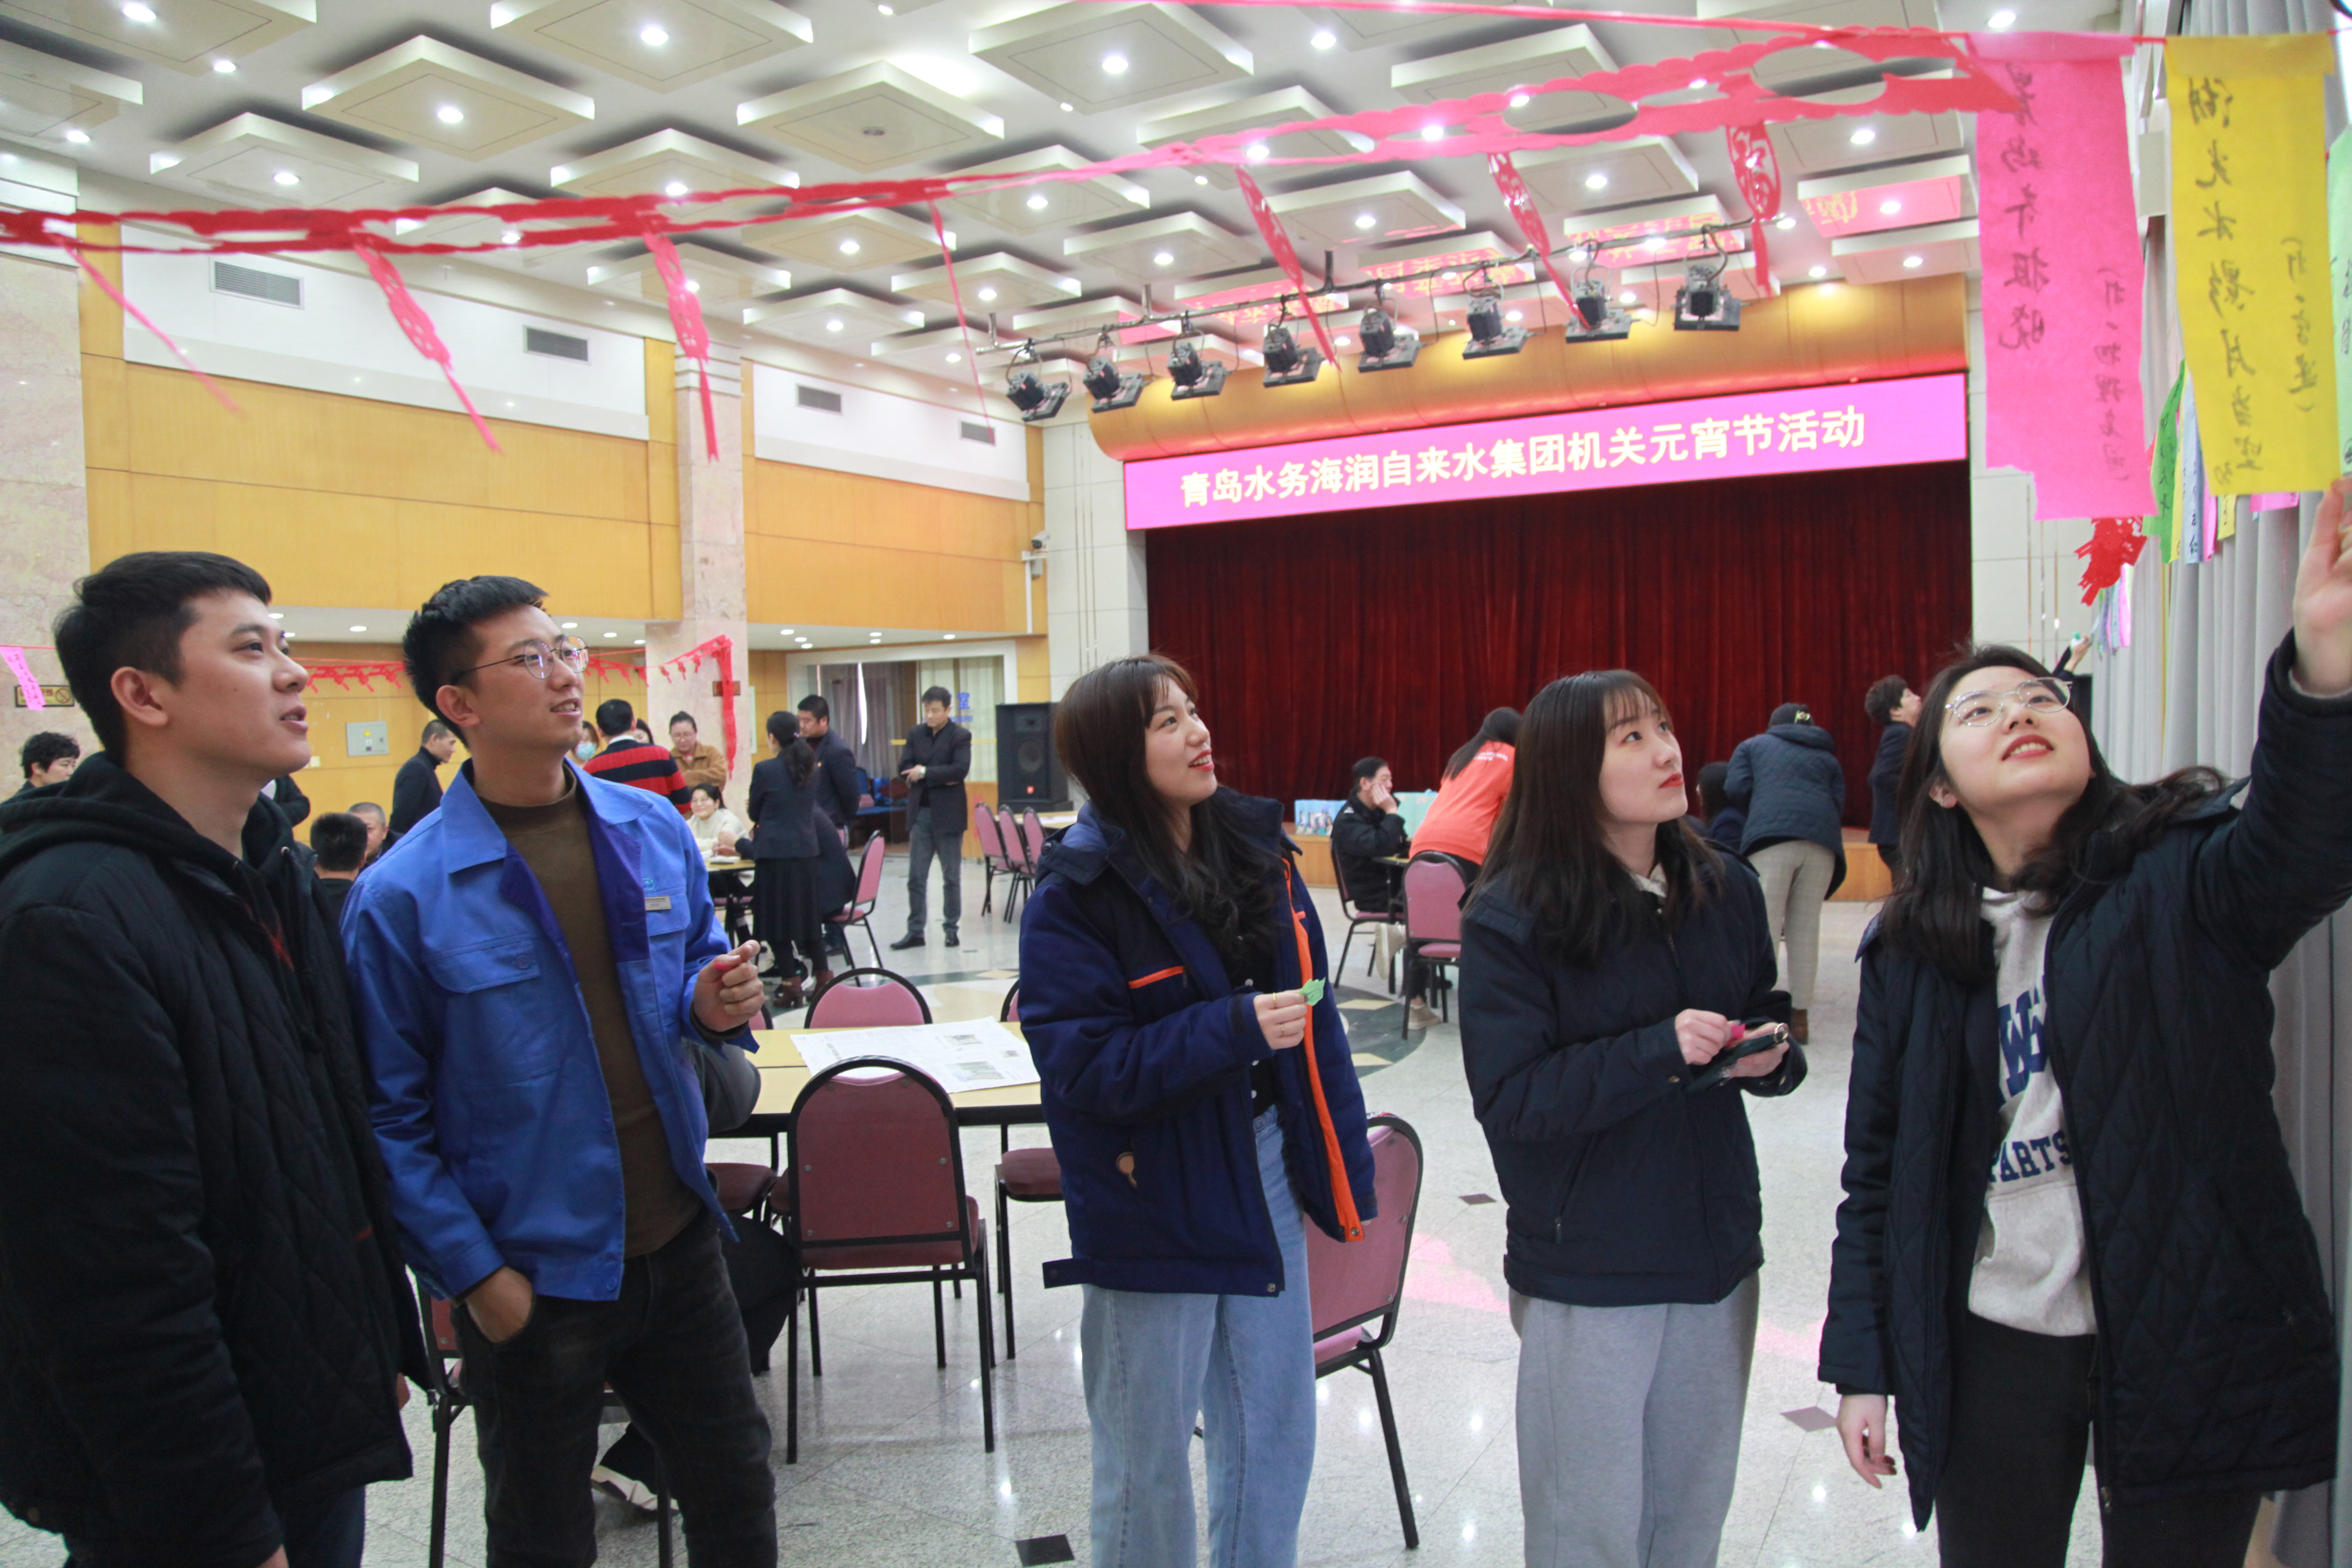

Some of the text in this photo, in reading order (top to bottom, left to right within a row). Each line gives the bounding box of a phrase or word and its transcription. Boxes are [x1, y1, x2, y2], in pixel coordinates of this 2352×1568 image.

[1180, 405, 1865, 508] 青岛水务海润自来水集团机关元宵节活动
[1988, 1129, 2073, 1183] ARTS
